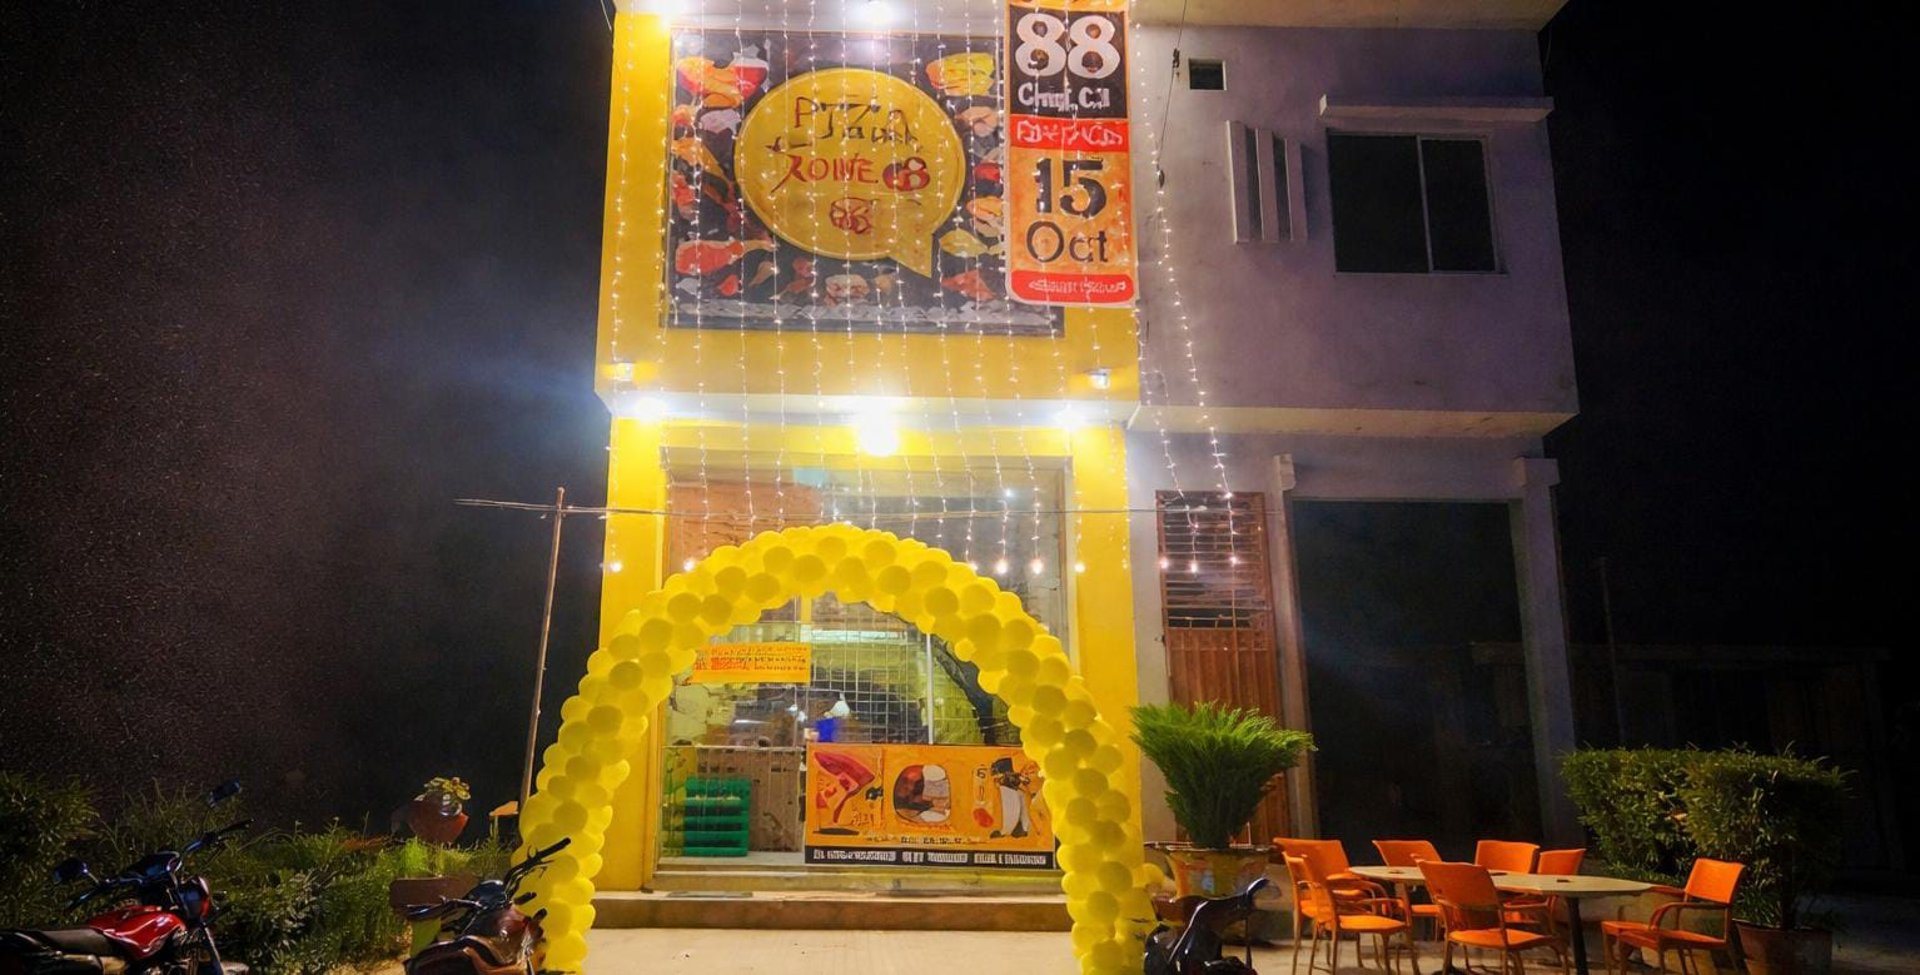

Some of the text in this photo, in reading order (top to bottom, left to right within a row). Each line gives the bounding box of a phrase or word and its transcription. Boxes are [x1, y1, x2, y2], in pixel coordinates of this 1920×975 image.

[1015, 13, 1120, 78] 88
[1035, 158, 1107, 218] 15
[1026, 221, 1109, 263] Oct
